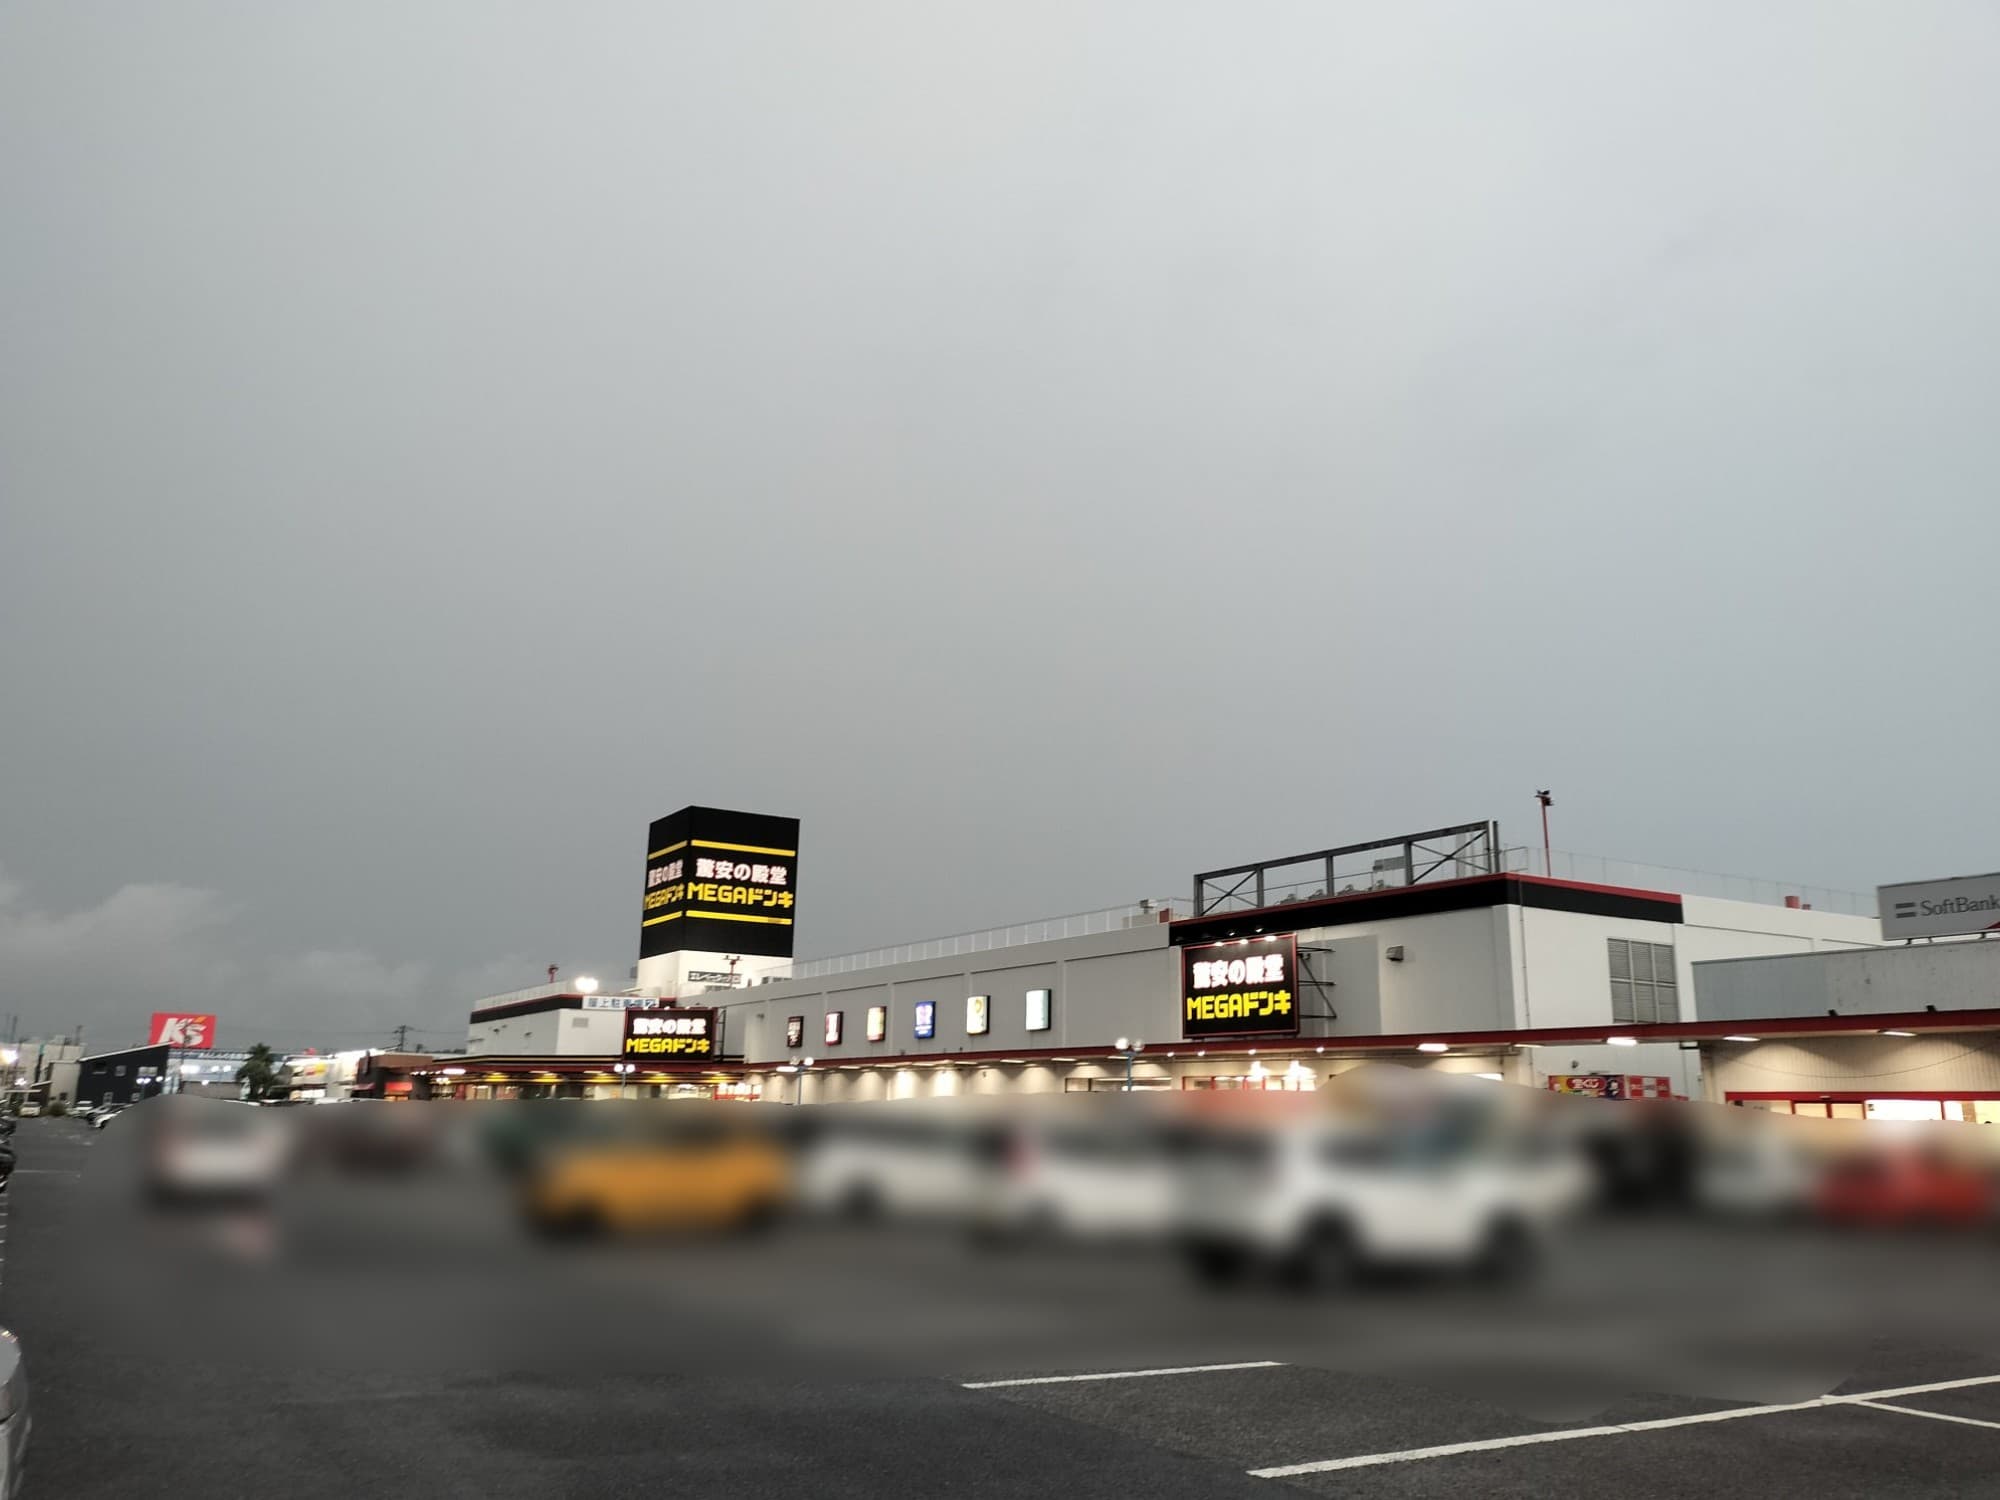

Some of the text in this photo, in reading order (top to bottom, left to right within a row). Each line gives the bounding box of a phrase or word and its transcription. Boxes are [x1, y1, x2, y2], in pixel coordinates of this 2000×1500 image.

[695, 858, 788, 885] 驚安の殿堂
[687, 882, 794, 908] MEGAドンキ
[1920, 894, 2000, 916] SoftBank
[1187, 990, 1292, 1021] MEGAドンキ
[625, 1038, 710, 1054] MEGAドンキ
